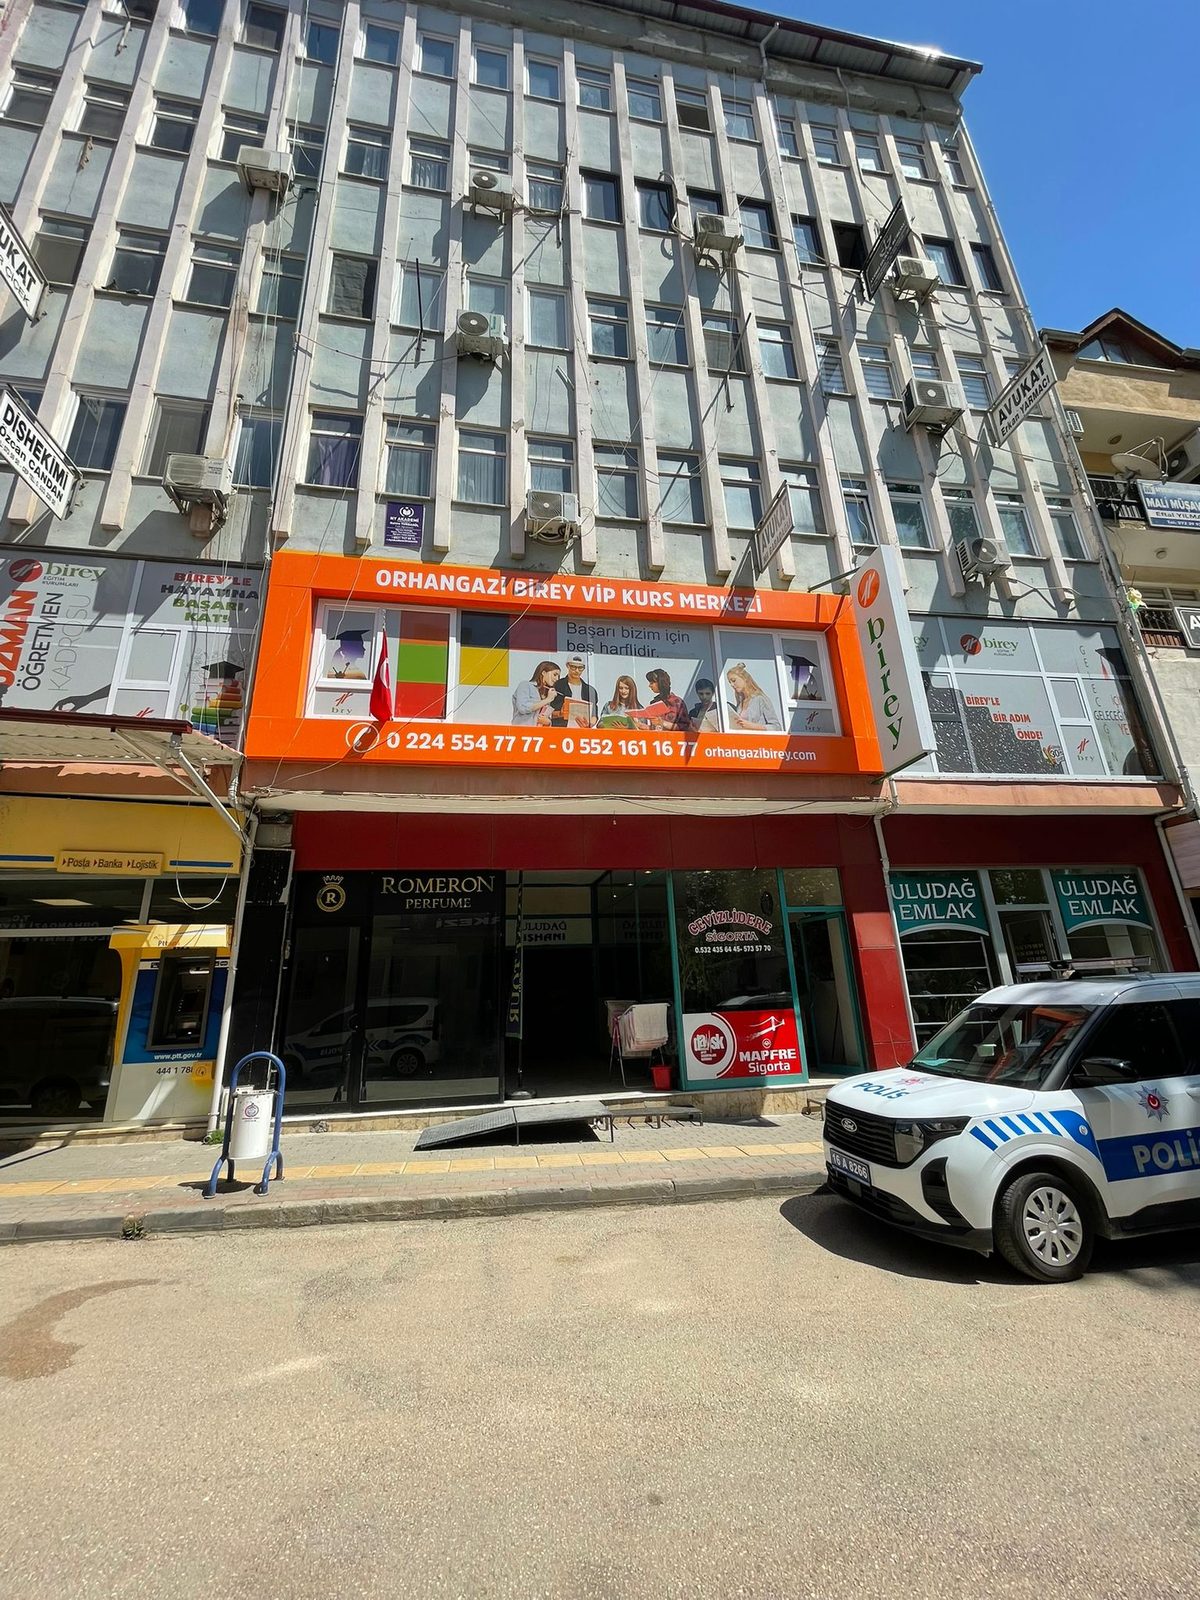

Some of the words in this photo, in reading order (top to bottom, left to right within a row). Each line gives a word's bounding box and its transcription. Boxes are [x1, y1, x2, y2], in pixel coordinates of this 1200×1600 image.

[0, 225, 36, 292] UKAT
[998, 358, 1045, 427] AVUKAT
[1000, 413, 1020, 437] Erkan
[1019, 375, 1050, 414] YARMACI
[3, 403, 69, 491] DİŞHEKİMİ
[28, 459, 64, 502] CANDAN
[1145, 496, 1169, 509] MALİ
[45, 561, 107, 582] birey
[376, 569, 506, 596] ORHANGAZİ
[512, 577, 575, 601] BİREY
[580, 583, 616, 603] VİP
[622, 588, 675, 608] KURS
[679, 592, 763, 614] MERKEZİ
[184, 612, 229, 623] KAT!
[16, 592, 64, 691] ÖĞRETMEN
[48, 594, 92, 691] KADROSU
[566, 622, 616, 641] Başarı
[621, 626, 661, 643] bizim
[665, 630, 690, 645] için
[567, 639, 595, 654] beş
[600, 642, 660, 659] harflidir.
[982, 637, 1019, 651] birey
[867, 617, 904, 751] birey
[966, 693, 1001, 706] BİREY'LE
[992, 710, 1008, 722] BİR
[1009, 713, 1031, 723] ADIM
[1017, 728, 1044, 740] ÖNDE!
[386, 731, 400, 749] 0
[406, 732, 445, 750] 224
[451, 734, 488, 752] 554
[493, 735, 517, 752] 77
[521, 736, 544, 753] 77
[561, 737, 574, 754] 0
[579, 738, 613, 756] 552
[618, 739, 647, 757] 161
[652, 740, 674, 758] 16
[677, 741, 699, 758] 77
[705, 745, 817, 761] orhangazibirey.com
[67, 857, 90, 868] Posta
[97, 858, 123, 869] Banka
[131, 859, 159, 871] Lojistik
[381, 875, 496, 895] ROMERON
[890, 877, 976, 901] ULUDAĞ
[1058, 875, 1138, 897] ULUDAĞ
[326, 892, 337, 904] R
[405, 897, 472, 910] PERFUME
[1068, 898, 1140, 916] EMLAK
[900, 902, 977, 920] EMLAK
[688, 907, 773, 936] CEVİZLİDERE
[705, 929, 759, 942] SİGORTA
[712, 945, 724, 953] 435
[755, 944, 763, 952] 57
[763, 944, 772, 952] 70
[154, 1052, 203, 1061] www.ptt.gov.tr
[739, 1048, 797, 1062] MAPFRE
[156, 1066, 171, 1075] 444
[174, 1066, 178, 1074] 1
[748, 1061, 791, 1075] Sigorta
[852, 1081, 911, 1100] POLİS
[832, 1152, 841, 1166] 16
[842, 1157, 849, 1170] A
[1132, 1130, 1200, 1173] POLİ
